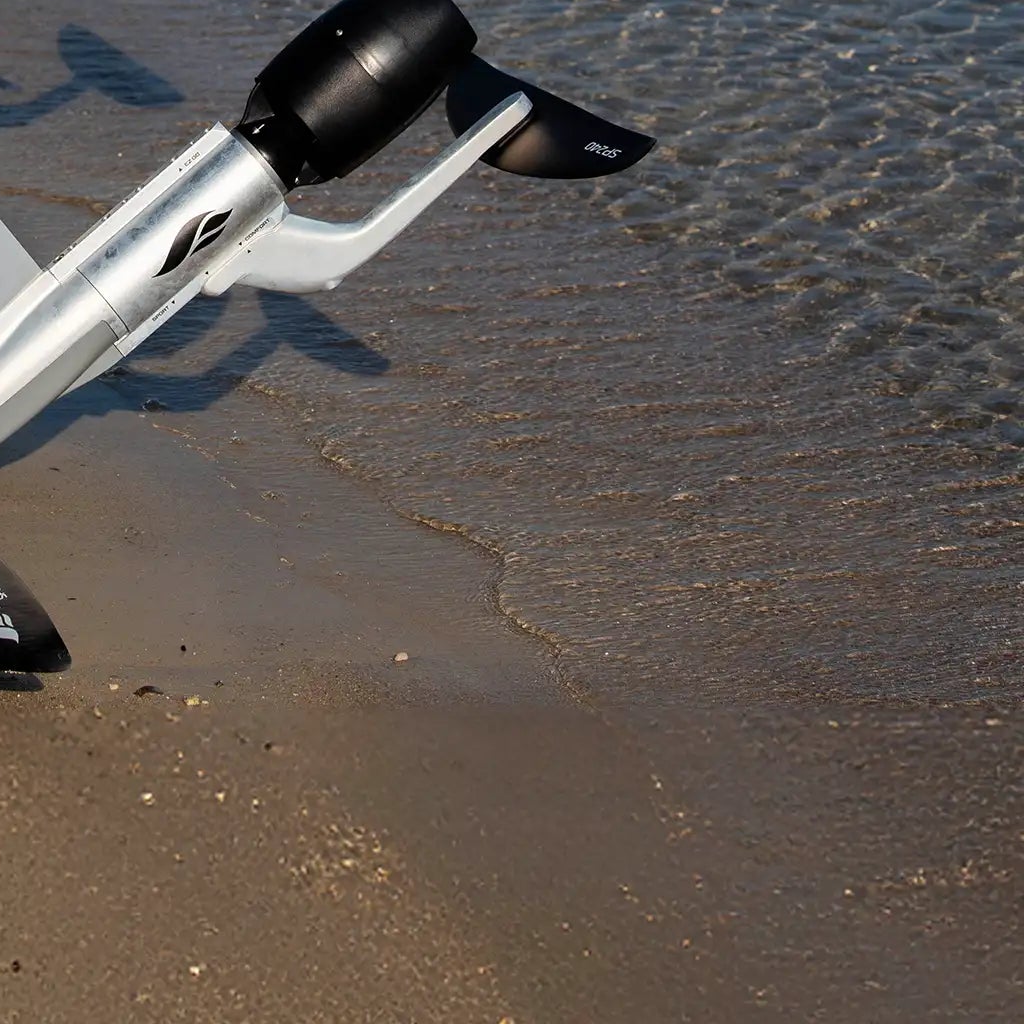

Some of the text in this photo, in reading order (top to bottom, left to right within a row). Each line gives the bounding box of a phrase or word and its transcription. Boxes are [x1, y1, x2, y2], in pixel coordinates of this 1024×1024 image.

[584, 141, 622, 158] SP240
[244, 218, 270, 241] COMFORT
[152, 305, 169, 321] SPORT
